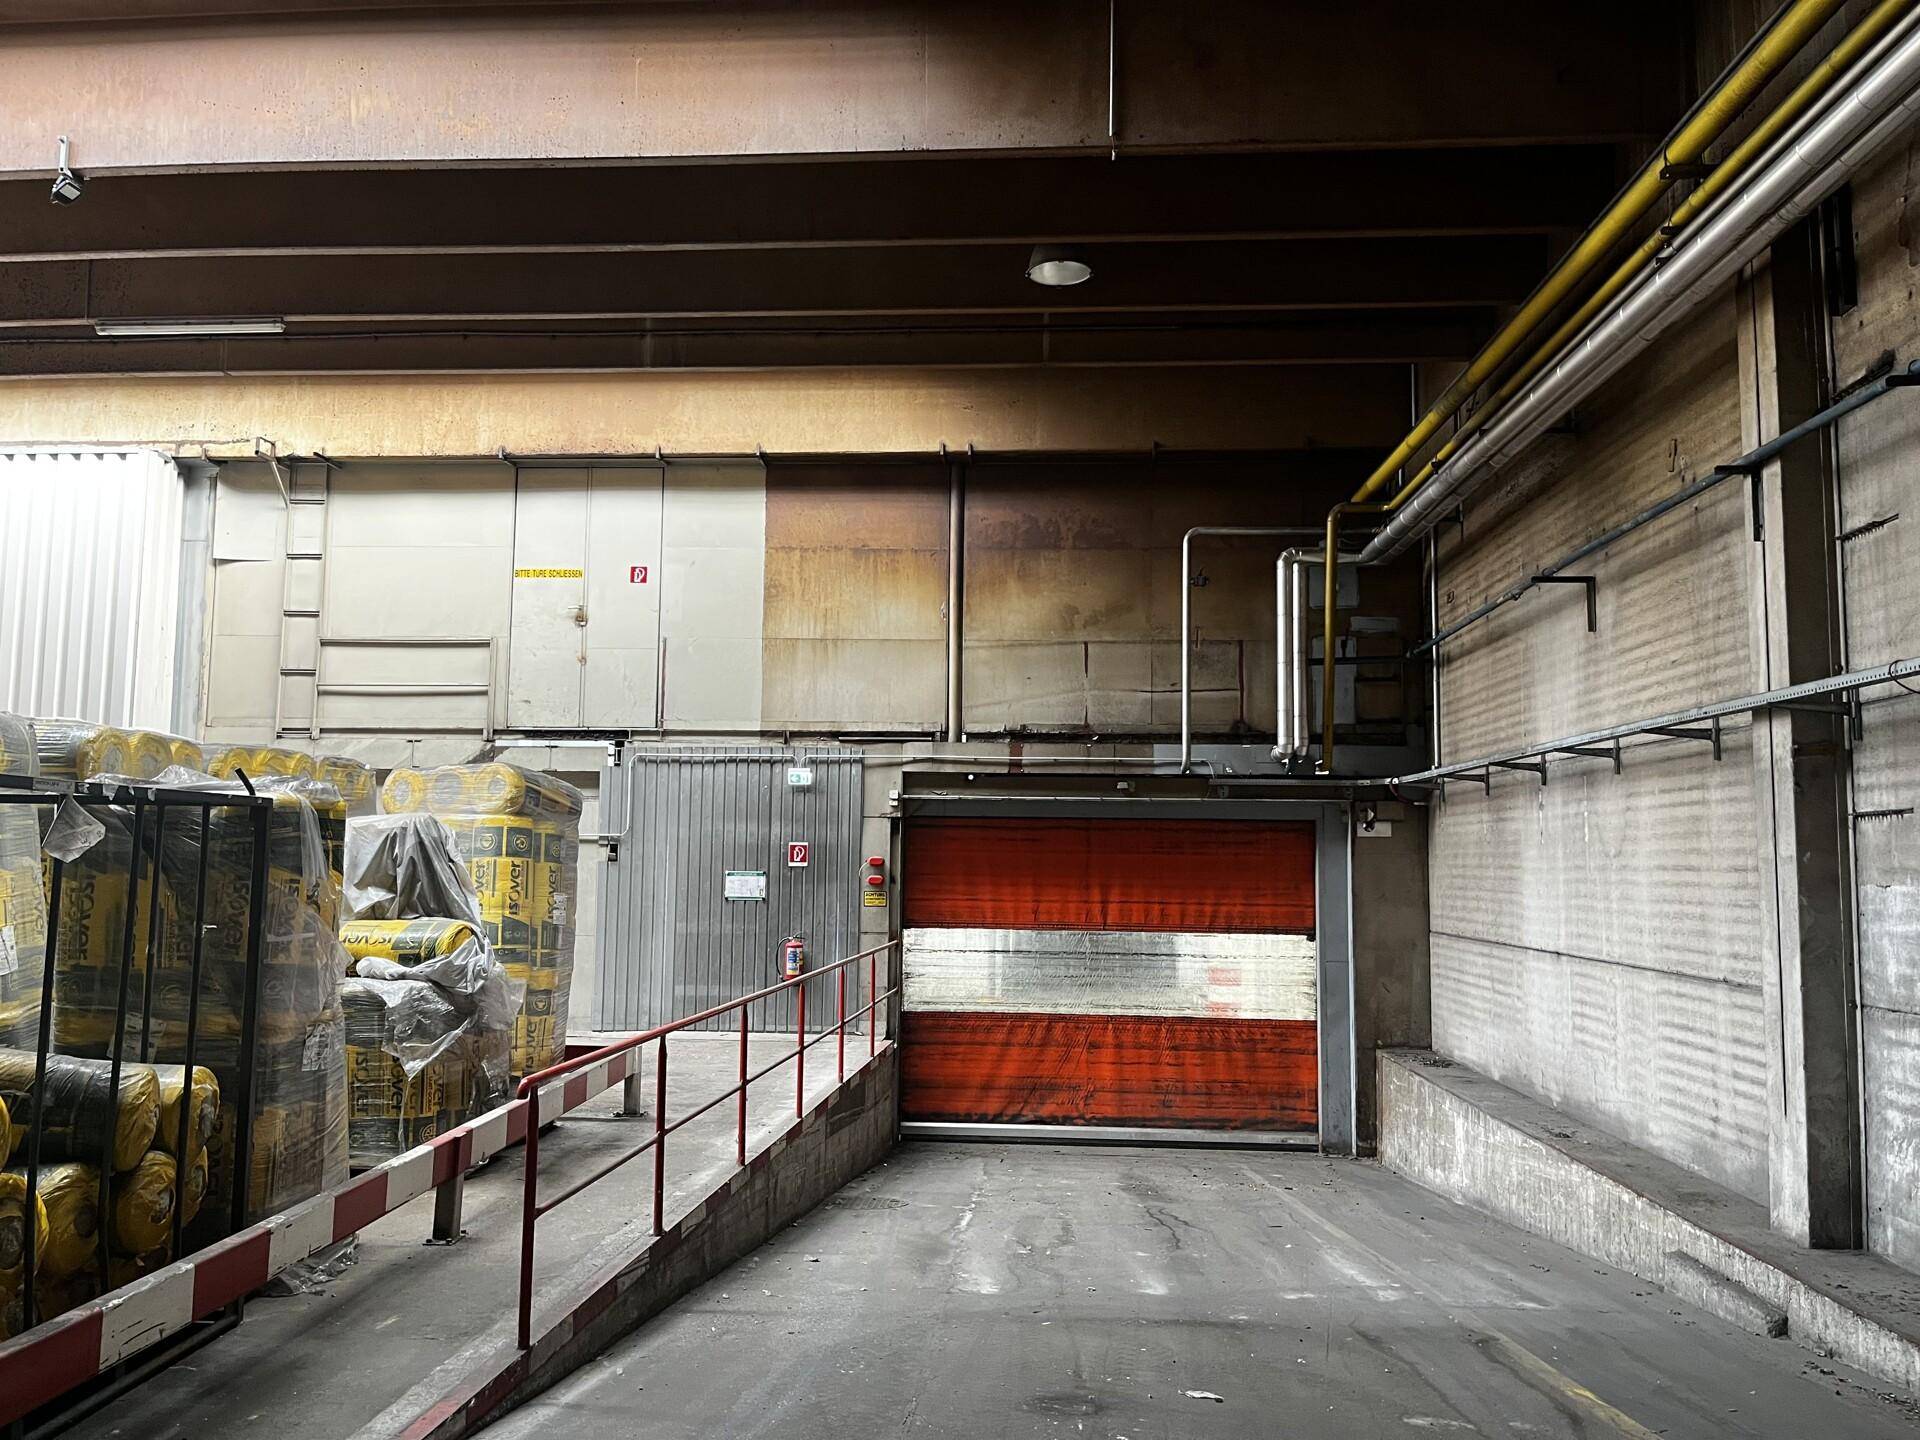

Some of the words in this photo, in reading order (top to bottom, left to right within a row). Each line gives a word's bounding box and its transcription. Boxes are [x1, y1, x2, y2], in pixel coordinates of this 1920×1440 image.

[515, 569, 531, 577] BITTE
[549, 569, 583, 578] SCHLIESSEN
[508, 860, 521, 915] isover
[547, 865, 558, 919] isover
[391, 1055, 405, 1112] sover
